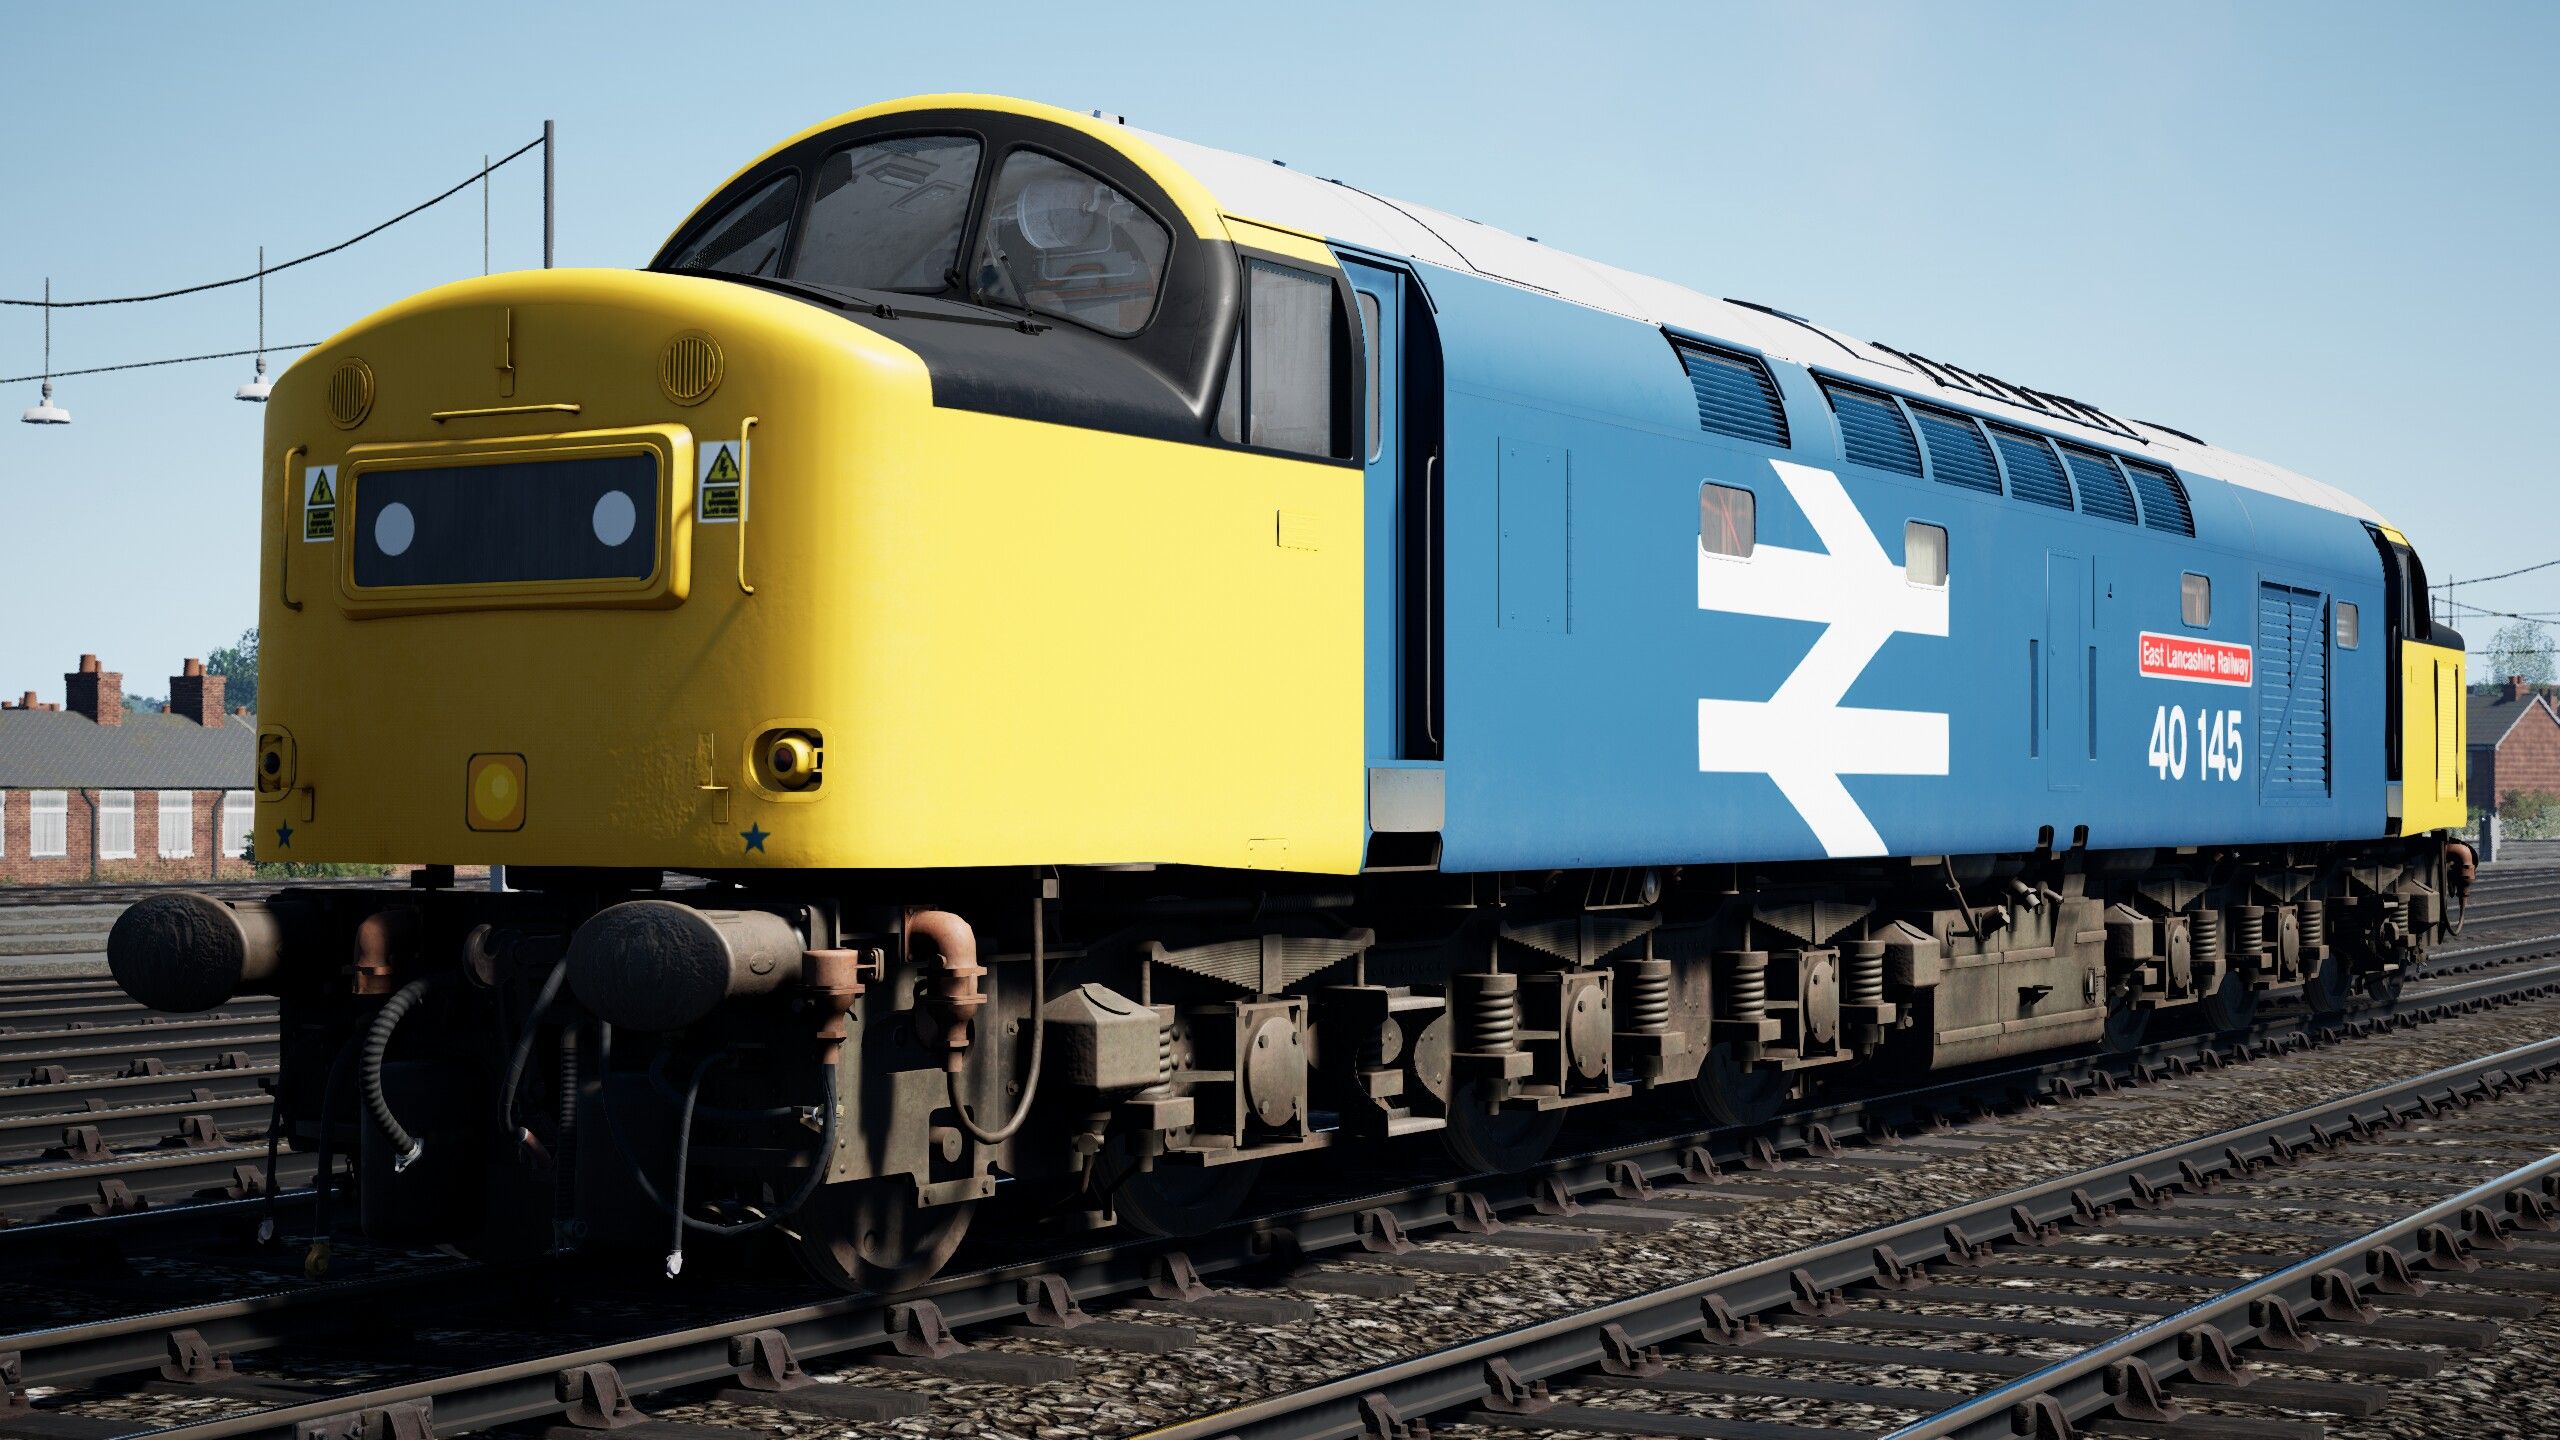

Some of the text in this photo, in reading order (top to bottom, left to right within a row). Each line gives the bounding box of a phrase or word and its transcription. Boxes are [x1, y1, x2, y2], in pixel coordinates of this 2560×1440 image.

[2143, 640, 2249, 681] East Lancashire Railway
[2148, 704, 2243, 782] 40 145
